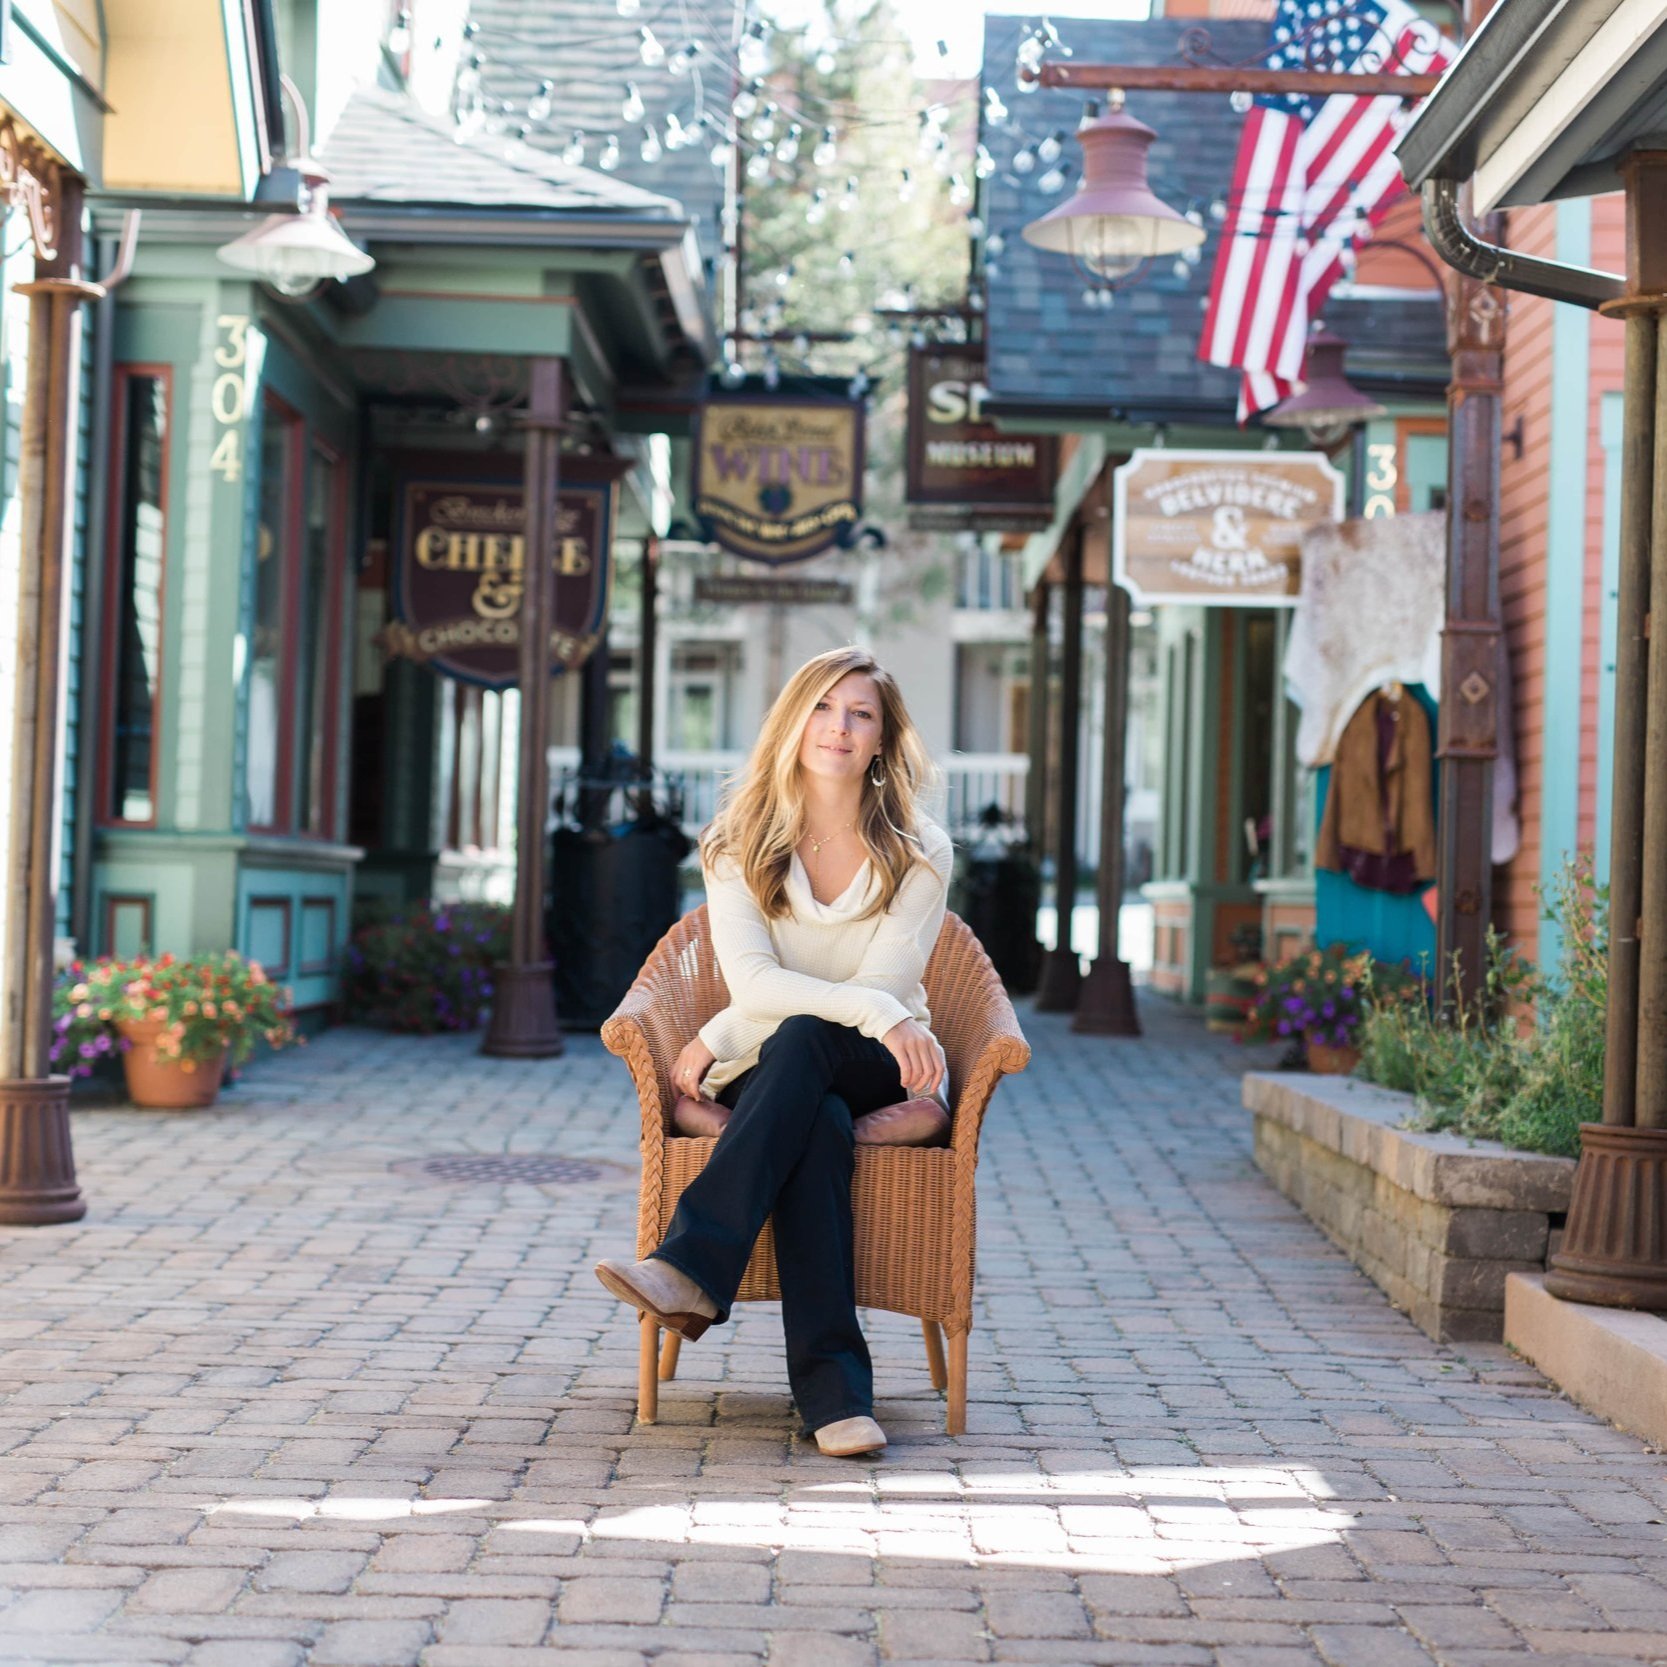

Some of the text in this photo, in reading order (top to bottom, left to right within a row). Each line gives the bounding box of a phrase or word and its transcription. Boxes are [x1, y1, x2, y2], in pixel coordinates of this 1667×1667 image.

[210, 314, 250, 483] 304
[709, 442, 846, 487] WINE
[926, 440, 1036, 468] MUSEUM
[1210, 504, 1249, 549] &
[471, 571, 524, 619] &
[418, 619, 577, 661] CHOCOTE
